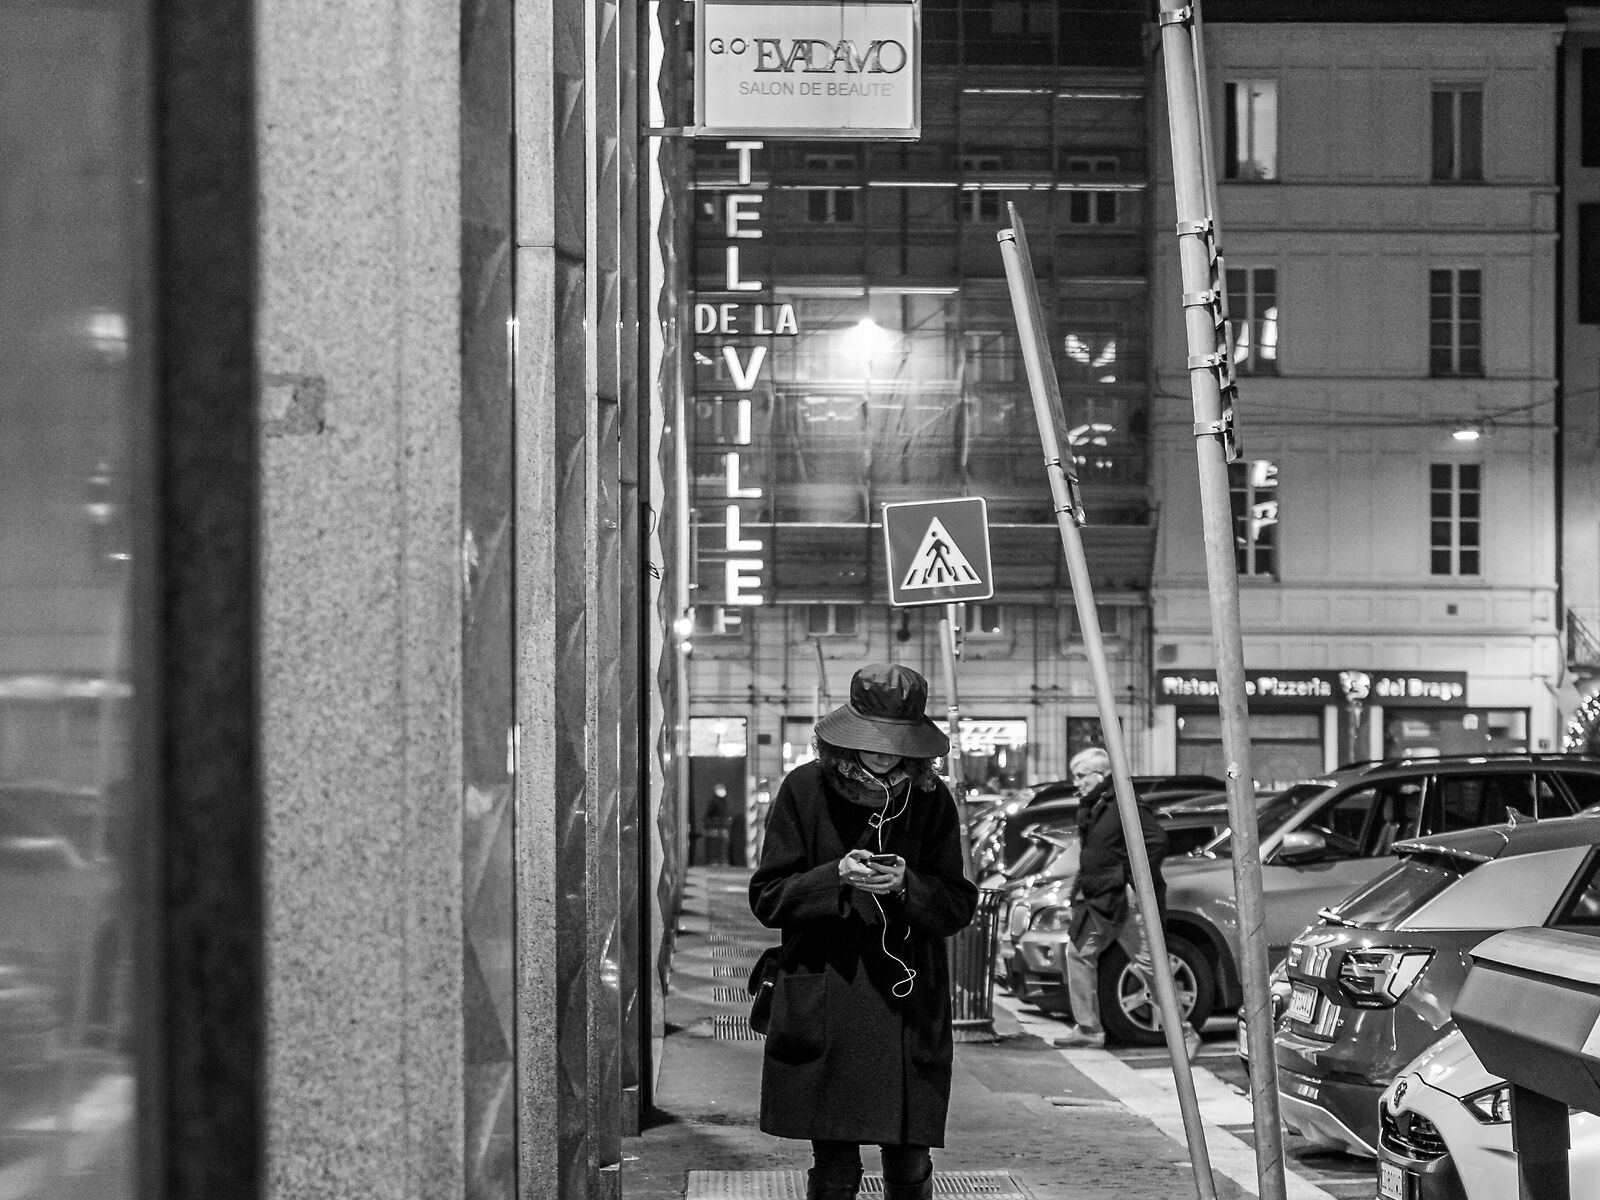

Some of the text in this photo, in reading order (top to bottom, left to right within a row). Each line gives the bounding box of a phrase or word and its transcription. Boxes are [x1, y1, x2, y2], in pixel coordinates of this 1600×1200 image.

[738, 81, 795, 96] SALON
[799, 82, 823, 96] DE
[694, 303, 799, 335] DE LA
[722, 345, 768, 606] VILLE
[1257, 676, 1332, 697] Pizzeria
[1375, 677, 1406, 698] del
